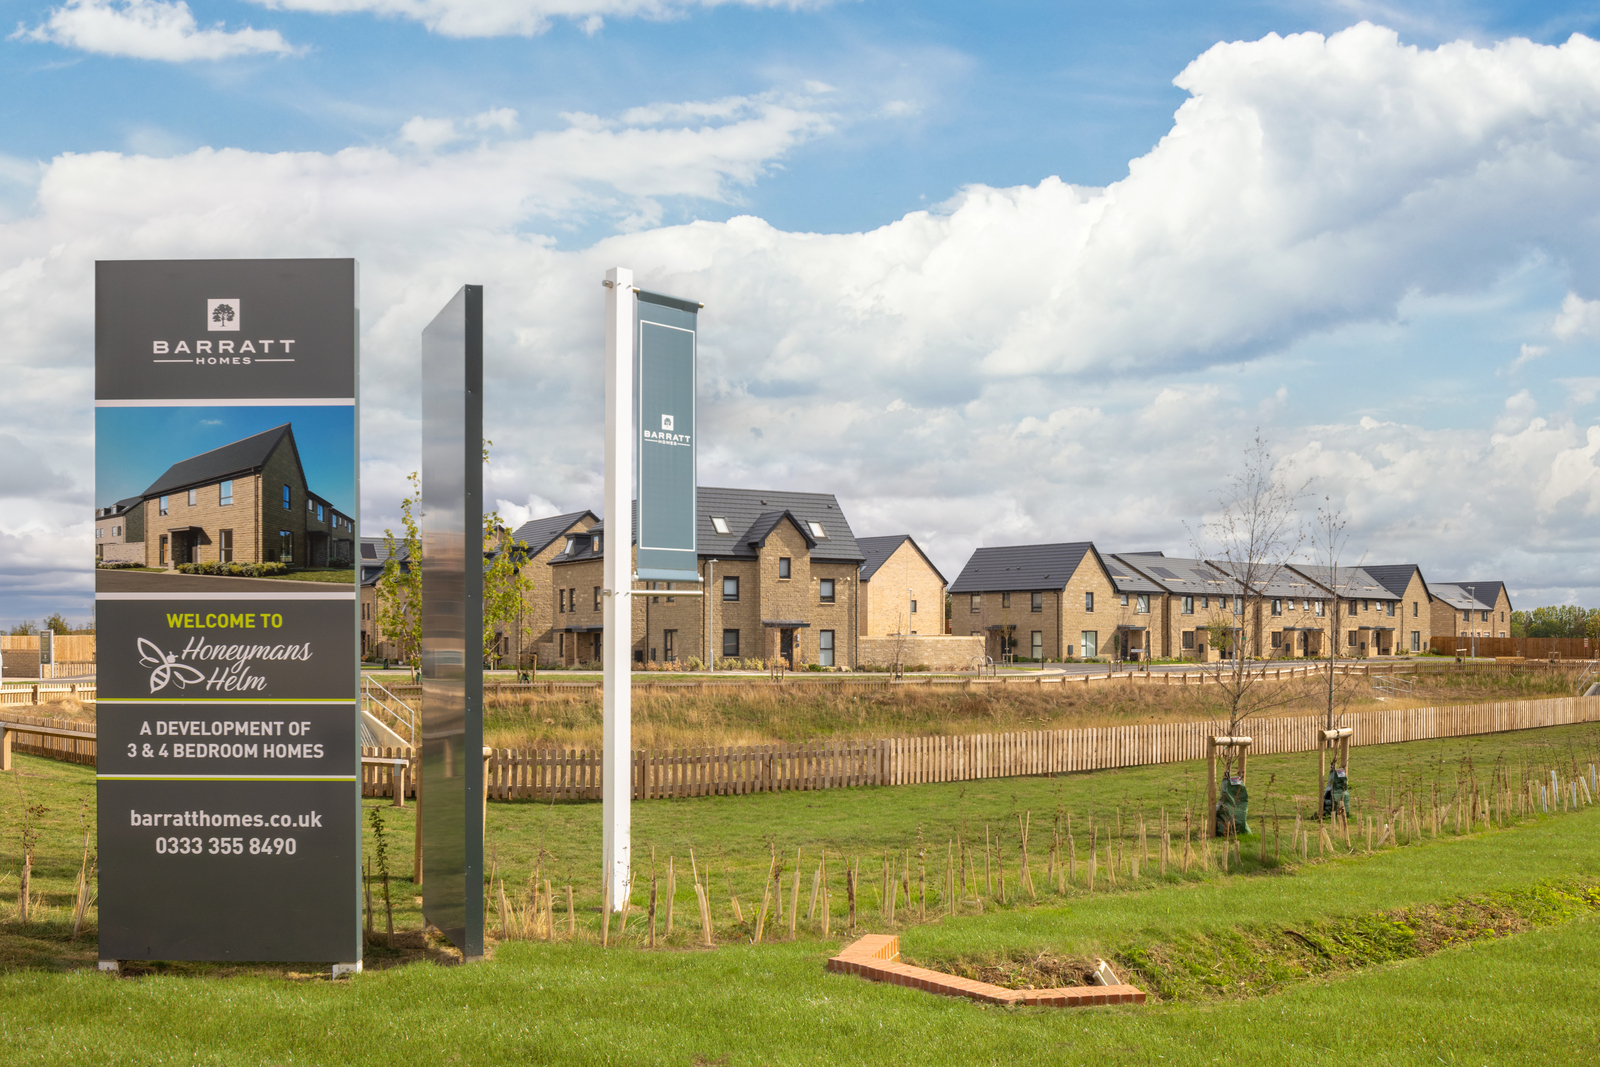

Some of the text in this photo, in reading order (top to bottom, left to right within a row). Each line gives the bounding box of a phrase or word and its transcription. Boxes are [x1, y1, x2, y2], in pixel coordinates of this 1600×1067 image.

[153, 340, 296, 354] BARRATT
[195, 357, 252, 365] HOMES
[644, 430, 691, 443] BARRATT
[166, 613, 283, 629] WELCOME TO
[181, 636, 313, 674] Honeymans
[206, 666, 268, 692] Helm
[139, 721, 311, 736] A DEVELOPMENT OF
[127, 743, 324, 759] 3 & 4 BEDROOM HOMES
[130, 809, 323, 828] barratthomes.co.uk
[155, 837, 297, 855] 0333 355 8490
